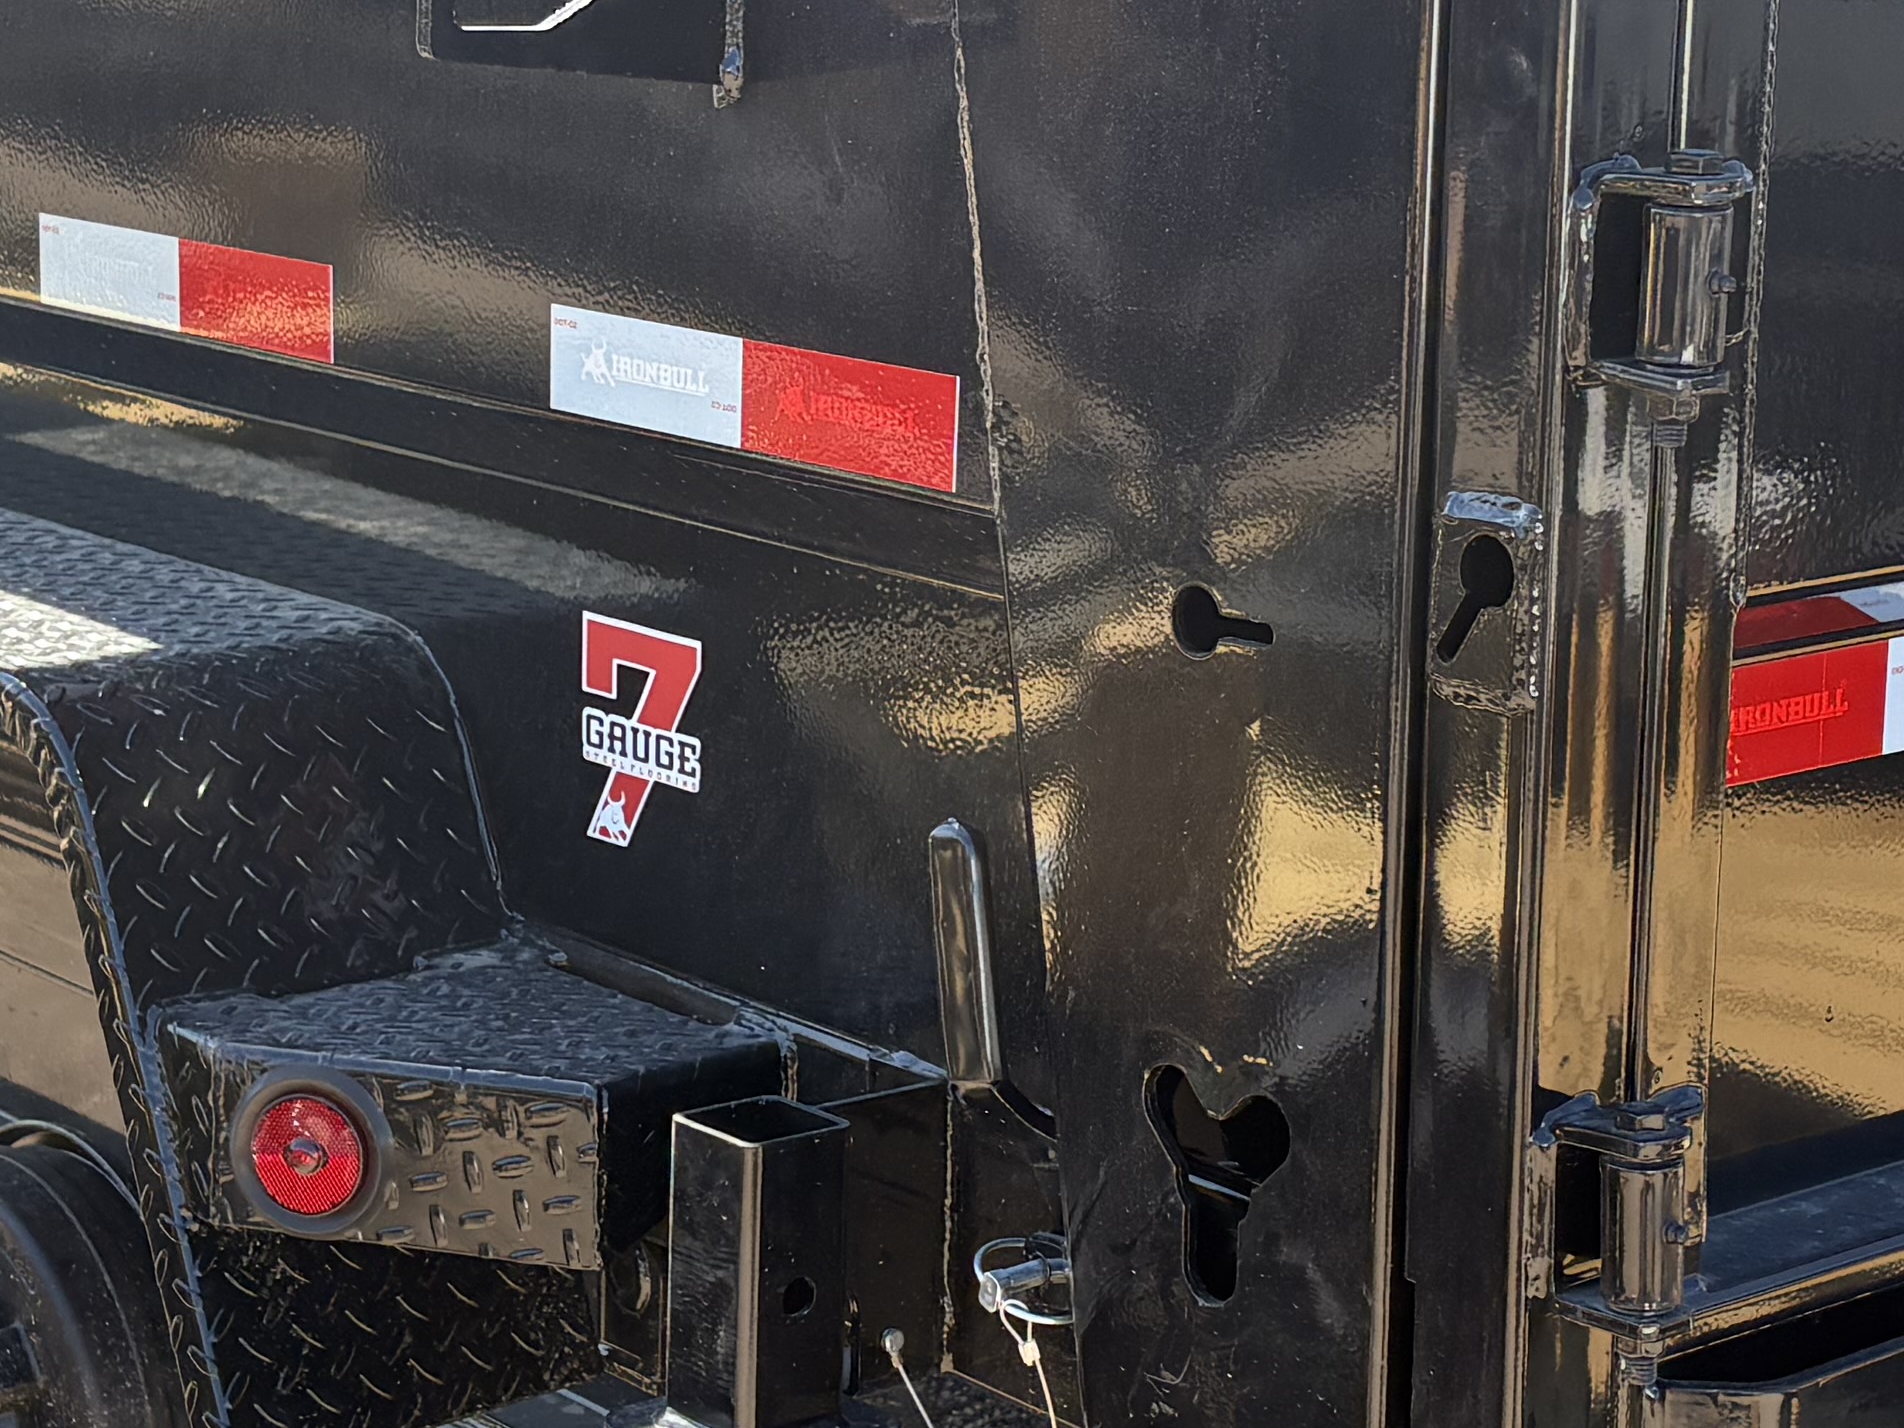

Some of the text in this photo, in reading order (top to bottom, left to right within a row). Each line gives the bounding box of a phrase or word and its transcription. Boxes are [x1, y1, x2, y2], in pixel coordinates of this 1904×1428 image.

[611, 354, 709, 394] IRONBULL
[582, 610, 702, 847] 7
[1730, 688, 1849, 734] IRONBULL
[585, 713, 698, 779] GAUGE
[585, 750, 698, 791] STEEL FLOORING
